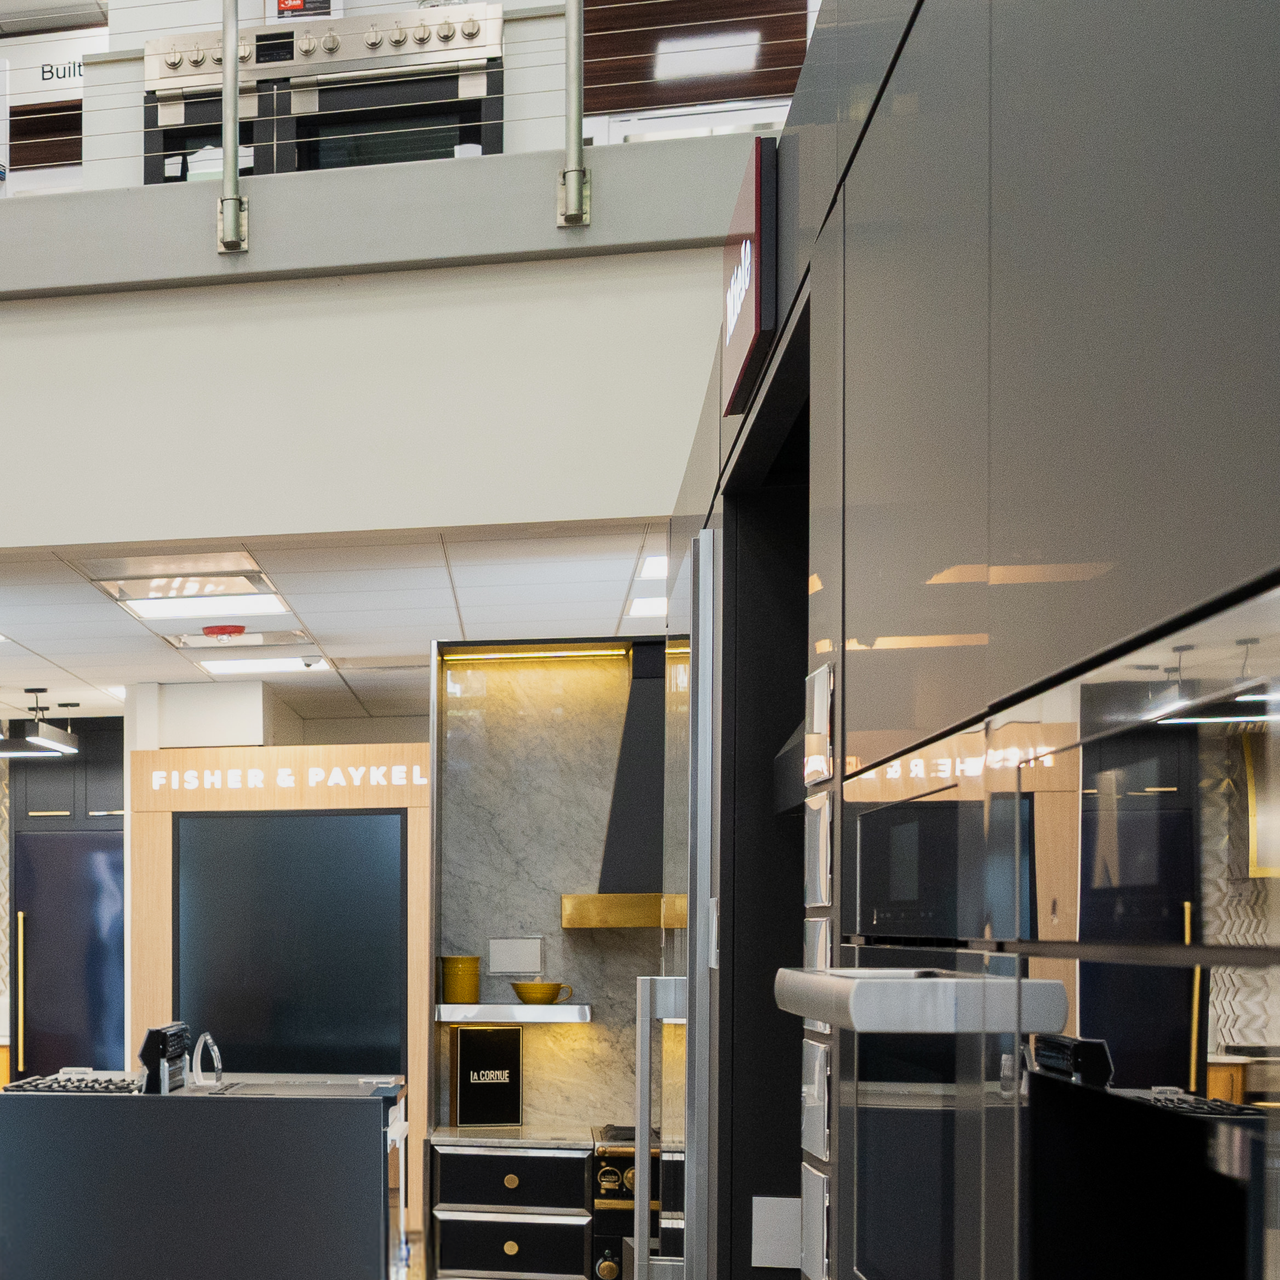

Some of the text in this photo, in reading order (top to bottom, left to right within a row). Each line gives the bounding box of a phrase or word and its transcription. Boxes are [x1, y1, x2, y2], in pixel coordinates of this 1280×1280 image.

[41, 61, 84, 81] Built
[151, 765, 428, 790] FISHER & PAYKEL
